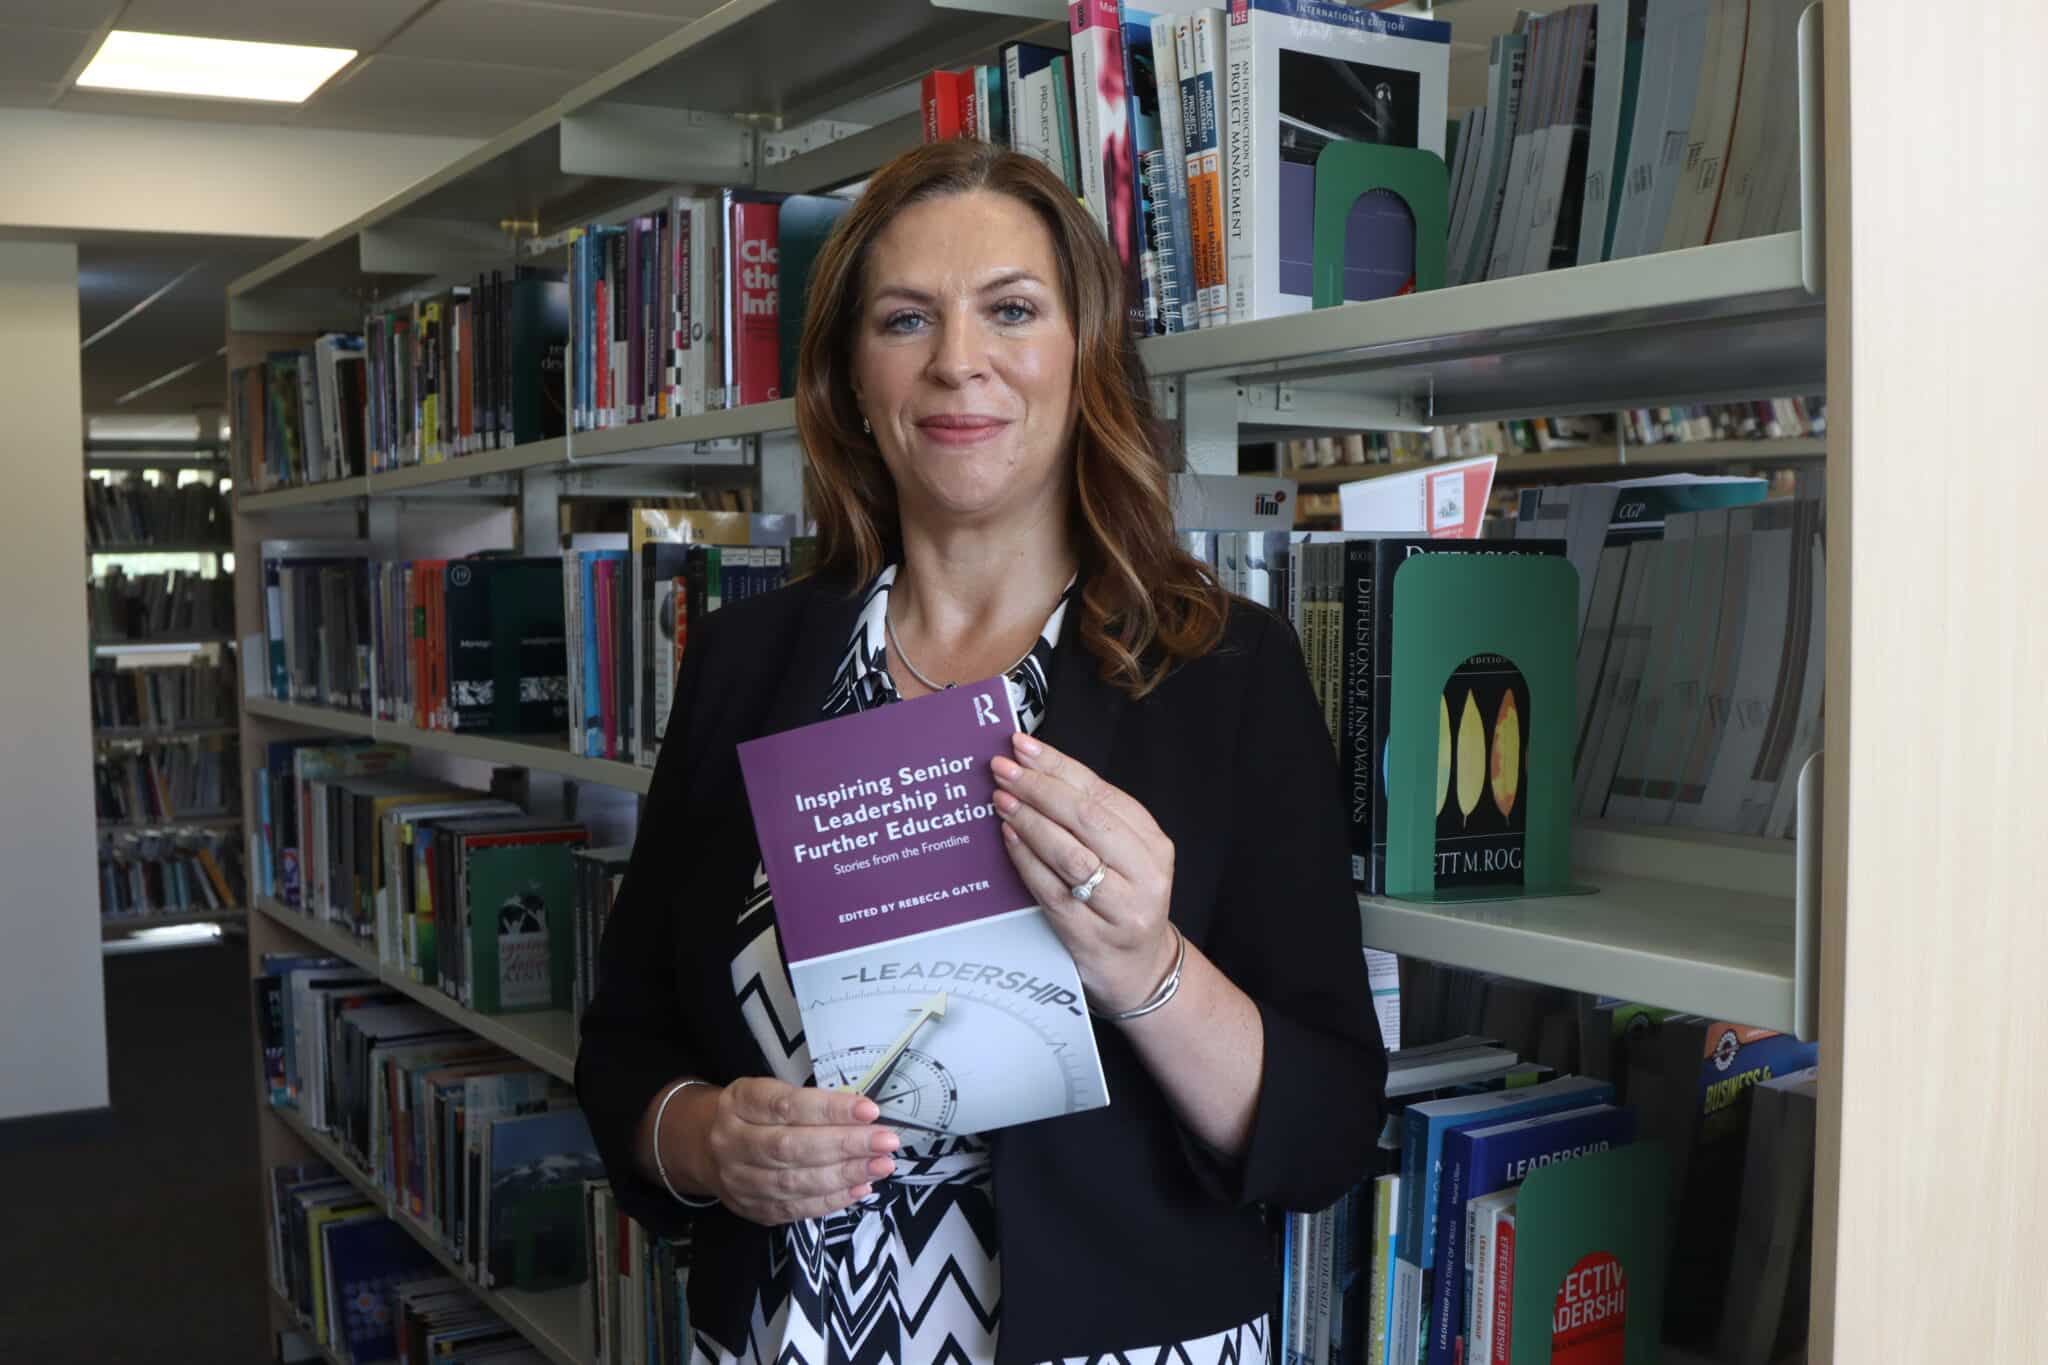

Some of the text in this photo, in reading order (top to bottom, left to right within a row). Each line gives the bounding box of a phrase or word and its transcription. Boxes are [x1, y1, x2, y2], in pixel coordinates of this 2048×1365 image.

[1232, 11, 1247, 24] ISE
[1296, 4, 1407, 32] INTERNATIONAL EDITION
[1040, 86, 1049, 144] PROJECT
[1188, 95, 1197, 135] PROJECT
[1198, 80, 1208, 144] MANAGEMENT
[1205, 90, 1214, 130] PROJECT
[1231, 64, 1241, 126] PROJECT
[1242, 77, 1250, 160] INTRODUCTION
[1231, 131, 1242, 240] MANAGEMENT
[1243, 162, 1250, 178] TO
[1205, 180, 1215, 229] PROJECT
[1356, 577, 1371, 675] DIFFUSION
[1348, 652, 1356, 685] FIFTH
[1470, 656, 1504, 665] EDITIO
[1356, 678, 1368, 697] OF
[795, 755, 974, 812] Inspiring Senior
[1353, 706, 1369, 824] INNOVATIONS
[814, 783, 967, 833] Leadership in
[793, 830, 879, 864] Further
[833, 834, 970, 876] Stories from the Frontline
[838, 879, 990, 924] EDITED BY REBECCA GATER
[1448, 1246, 1455, 1259] OF
[1449, 1220, 1457, 1245] CRISIS
[1445, 1288, 1452, 1297] IN
[1475, 1235, 1487, 1341] LESSONS IN LEADERSHIP
[1496, 1236, 1508, 1361] EFFECTIVE LEADERSHIP
[1558, 1261, 1623, 1303] ECTIV
[1440, 1298, 1450, 1351] LEADERSHIP
